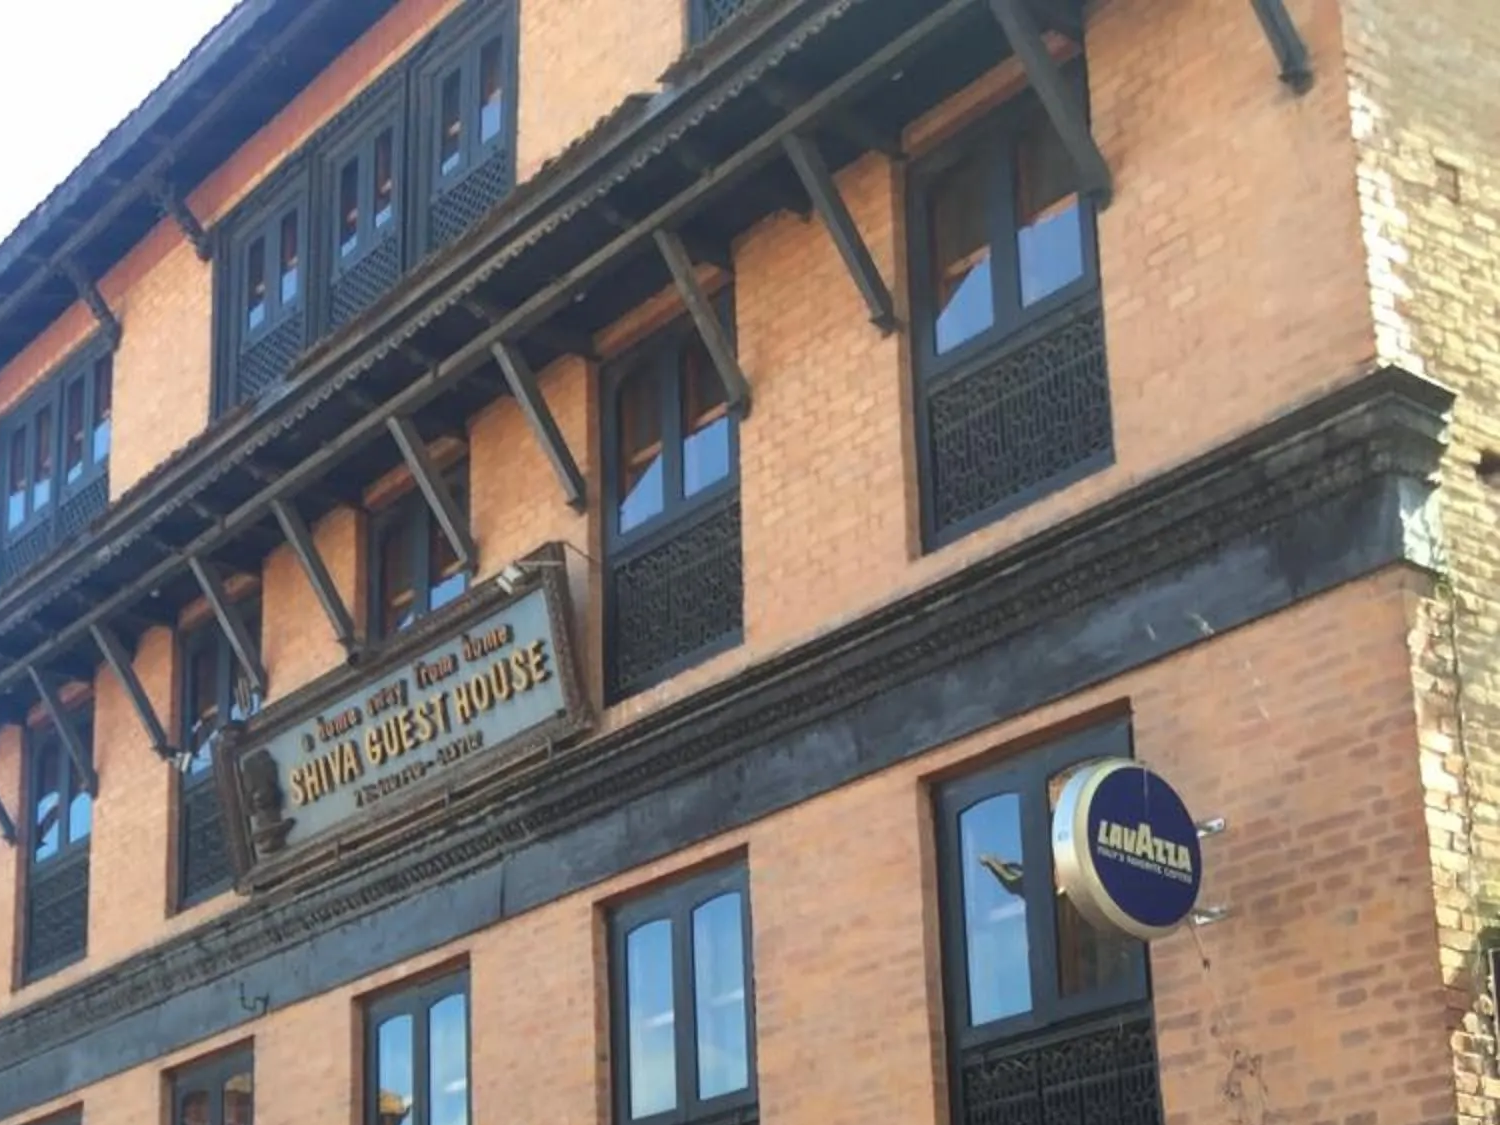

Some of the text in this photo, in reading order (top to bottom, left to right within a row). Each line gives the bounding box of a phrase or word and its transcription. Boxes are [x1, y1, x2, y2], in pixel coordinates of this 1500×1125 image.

[288, 746, 361, 806] SHIVA
[365, 693, 449, 766] GUEST
[453, 639, 550, 724] HOUSE
[1097, 820, 1192, 872] LAVAZZA
